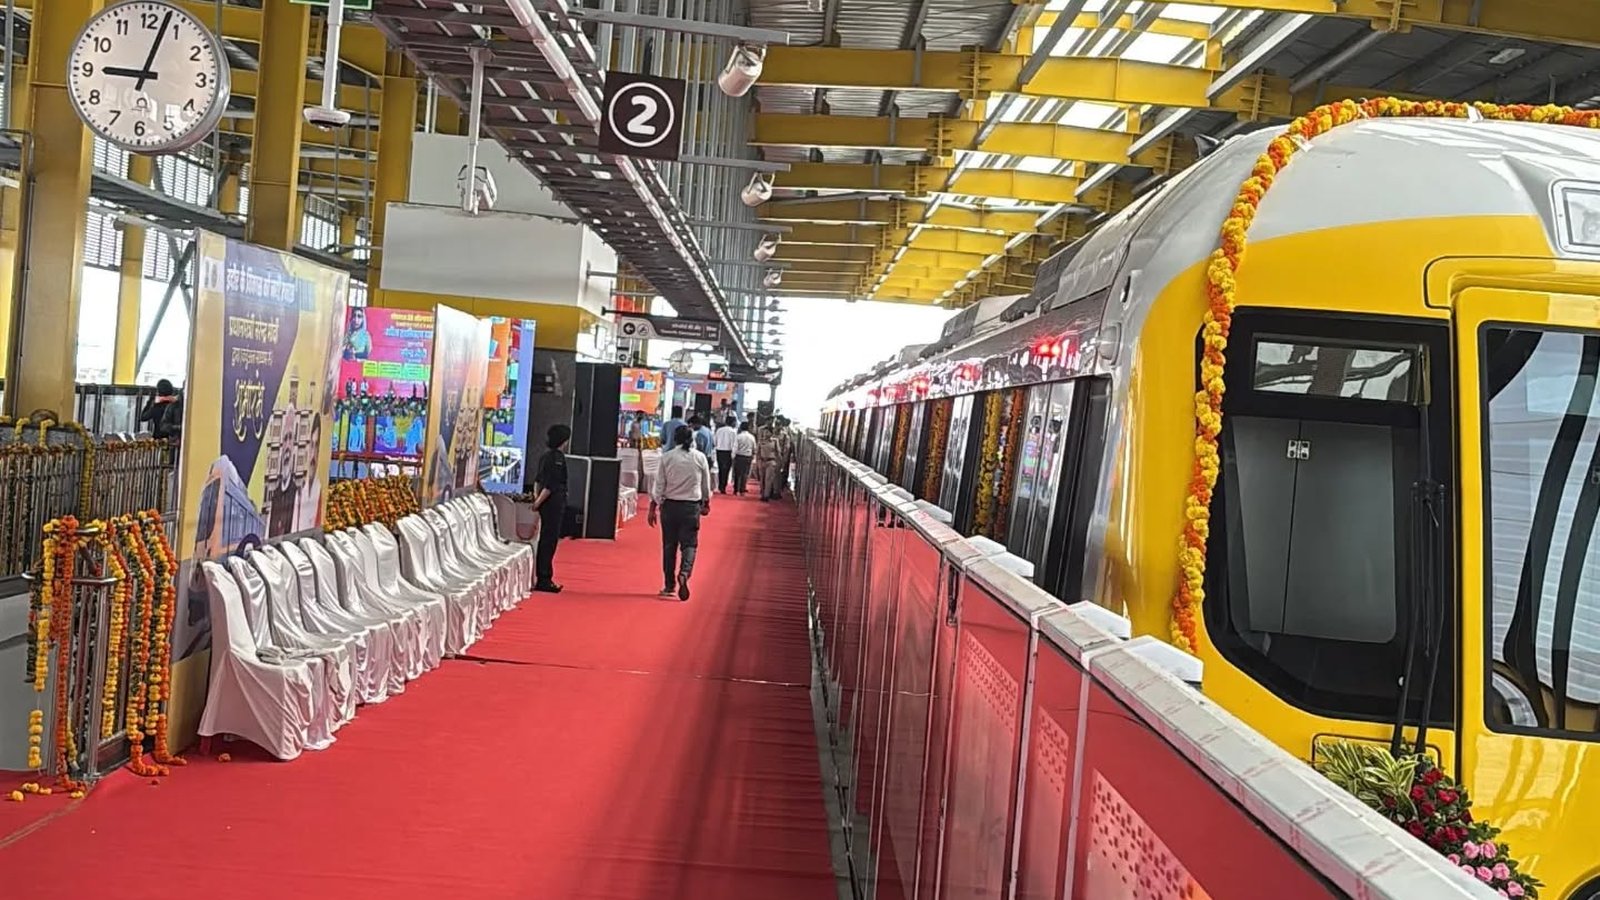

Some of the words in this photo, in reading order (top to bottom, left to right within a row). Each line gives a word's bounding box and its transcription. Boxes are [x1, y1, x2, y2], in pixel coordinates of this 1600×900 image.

[116, 19, 129, 35] 11
[141, 13, 158, 30] 12
[173, 24, 179, 40] 1
[93, 36, 112, 53] 10
[189, 45, 201, 62] 2
[82, 62, 94, 77] 9
[195, 72, 207, 88] 3
[89, 89, 101, 105] 8
[183, 99, 196, 113] 4
[109, 110, 121, 126] 7
[627, 94, 658, 135] 2
[134, 121, 145, 137] 6
[163, 115, 174, 131] 5
